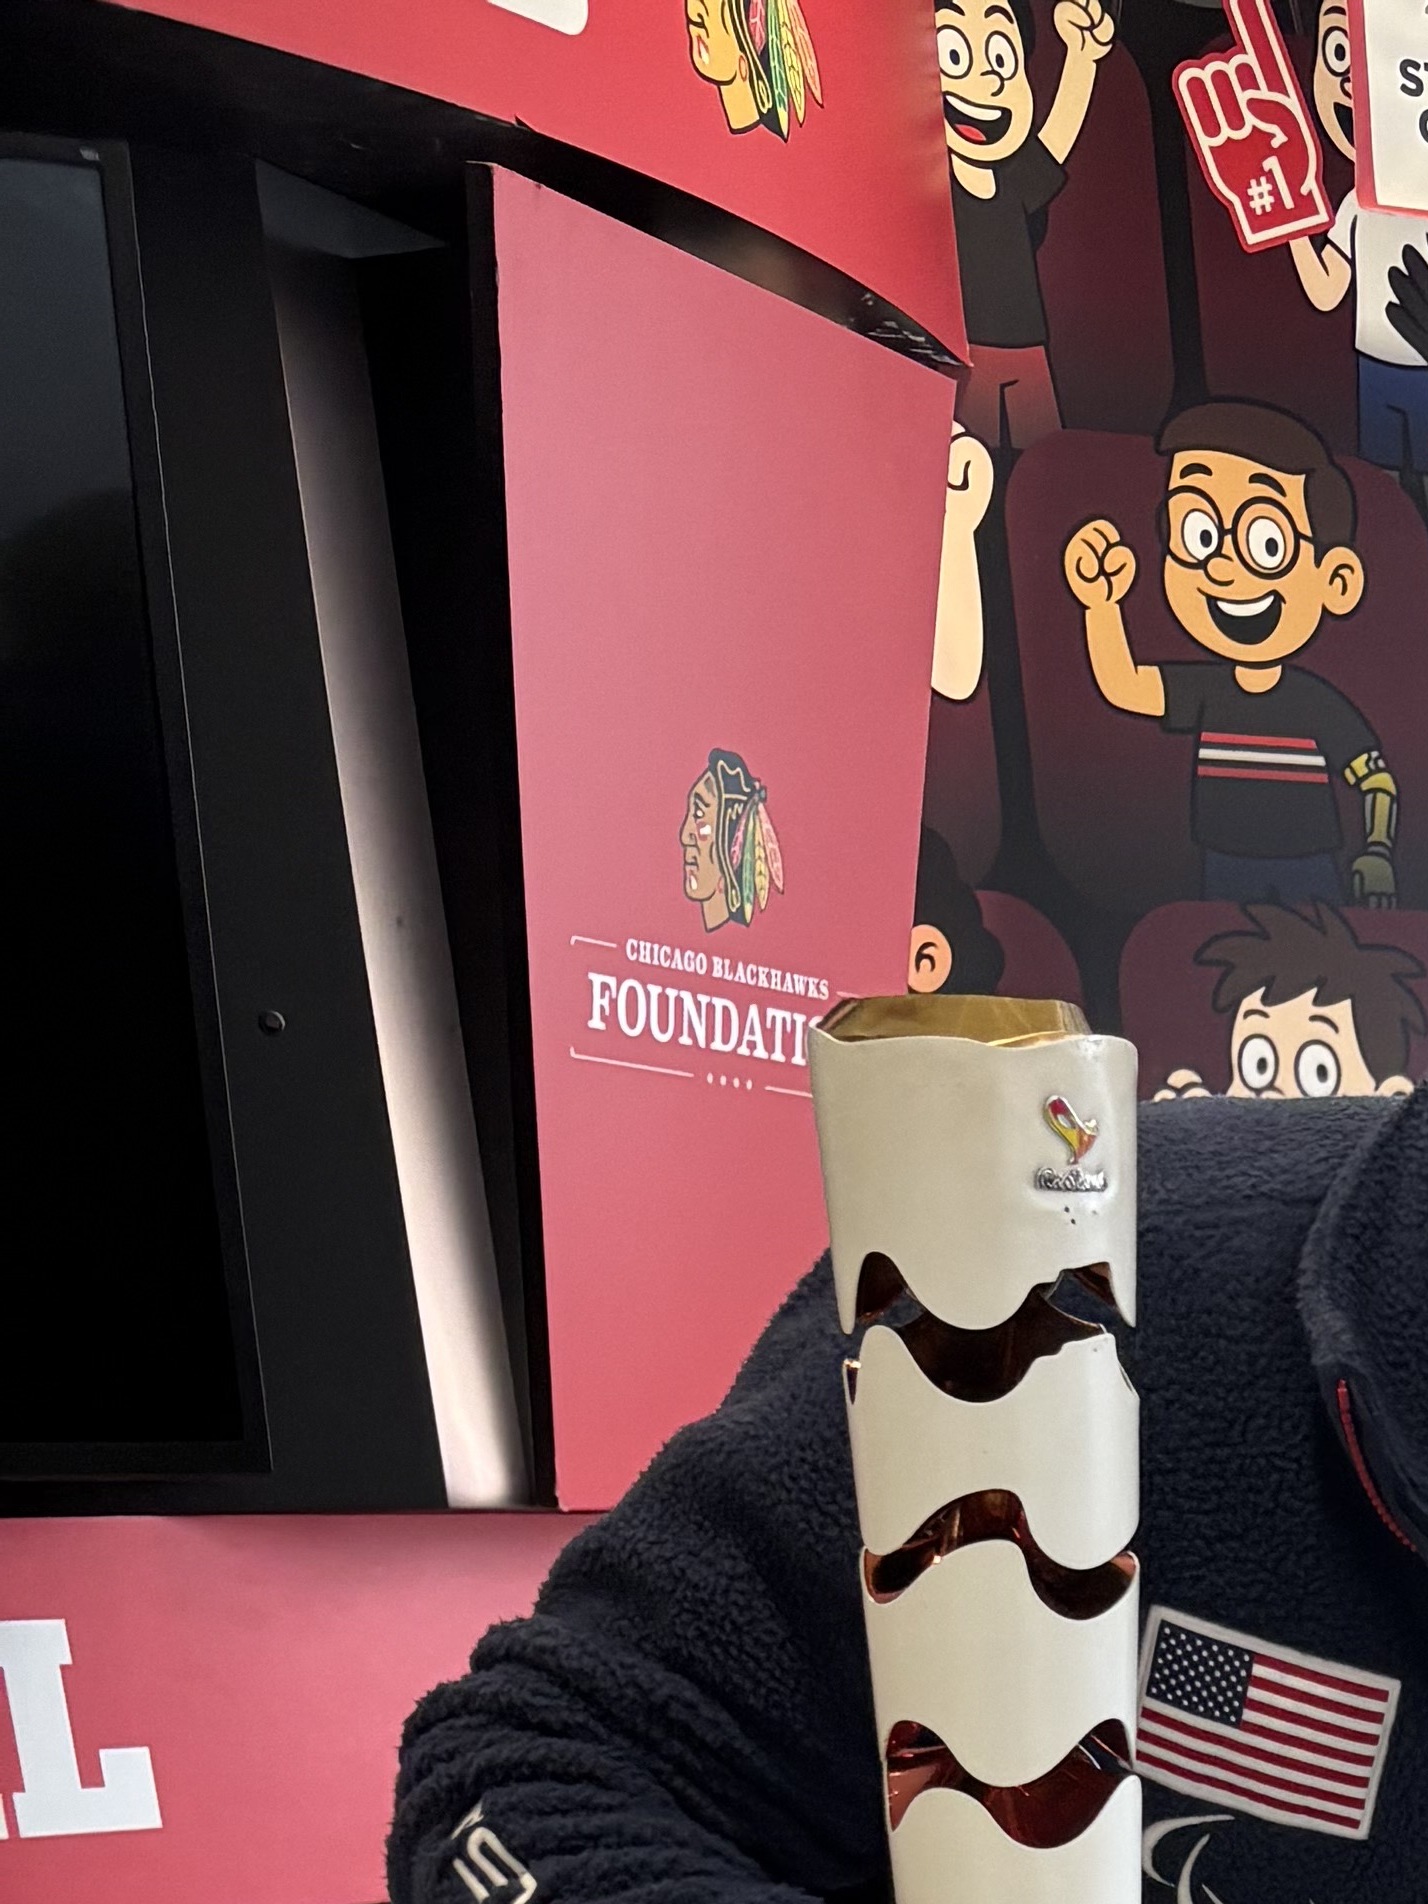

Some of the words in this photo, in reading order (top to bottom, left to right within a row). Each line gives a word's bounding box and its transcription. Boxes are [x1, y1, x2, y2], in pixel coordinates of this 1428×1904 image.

[1246, 155, 1295, 216] #1
[625, 938, 708, 977] CHICAGO
[711, 954, 830, 1001] BLACKHAWKS
[587, 971, 822, 1067] FOUNDATI
